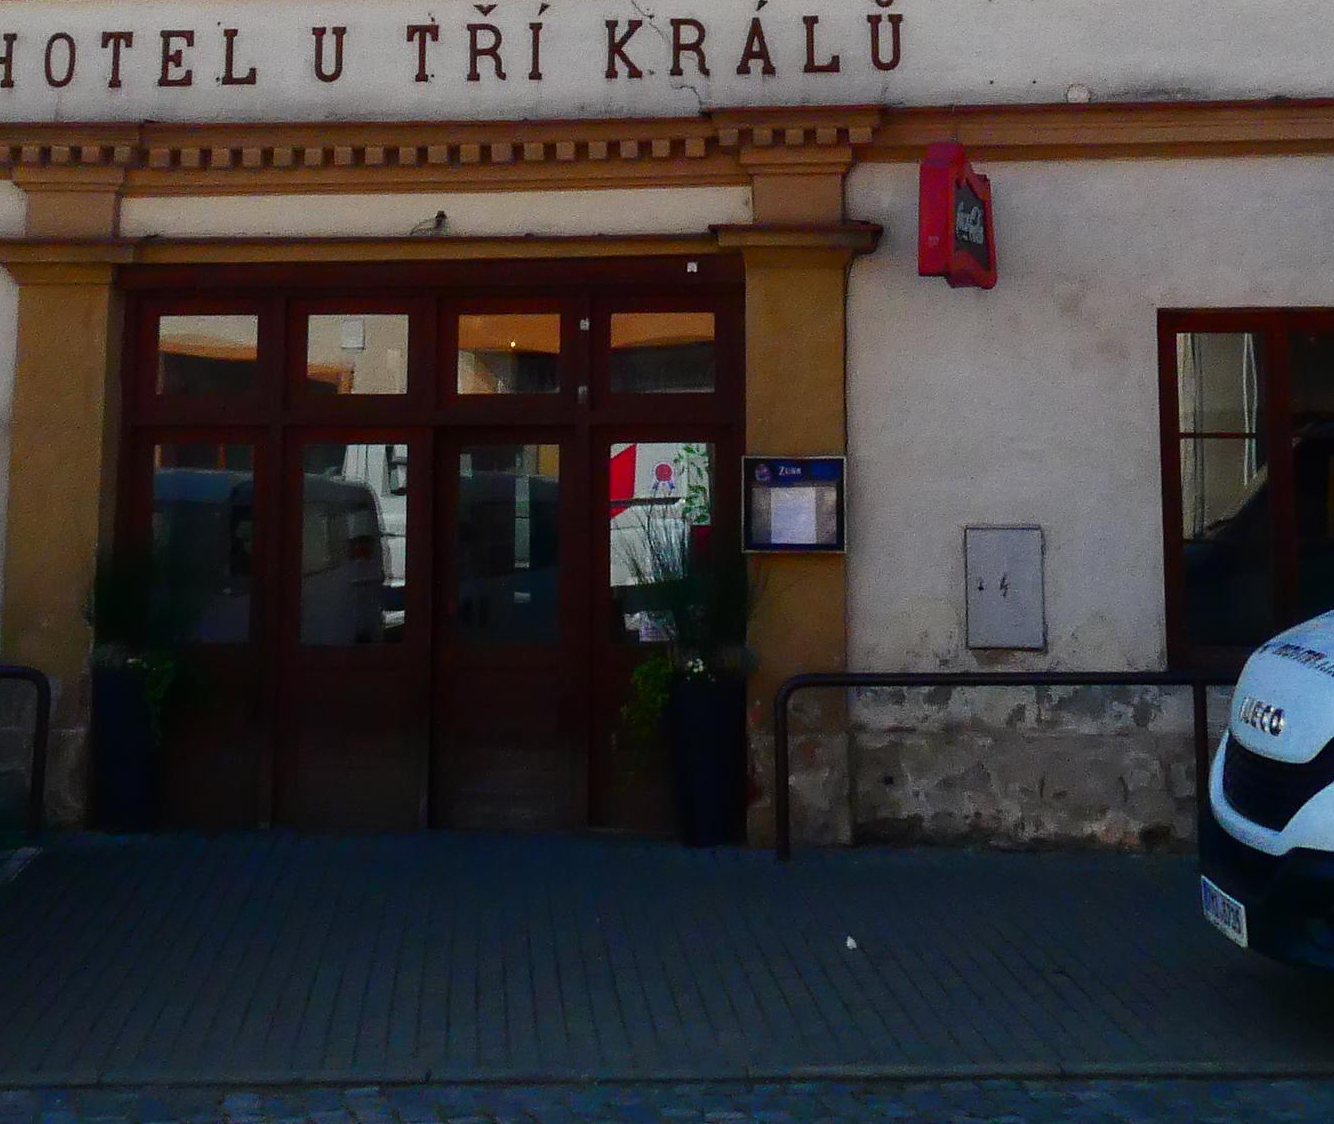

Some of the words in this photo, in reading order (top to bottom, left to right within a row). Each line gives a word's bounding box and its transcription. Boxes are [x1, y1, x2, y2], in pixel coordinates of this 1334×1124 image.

[312, 25, 348, 83] U
[406, 2, 552, 83] TŘÍ
[1239, 696, 1286, 737] IVECO
